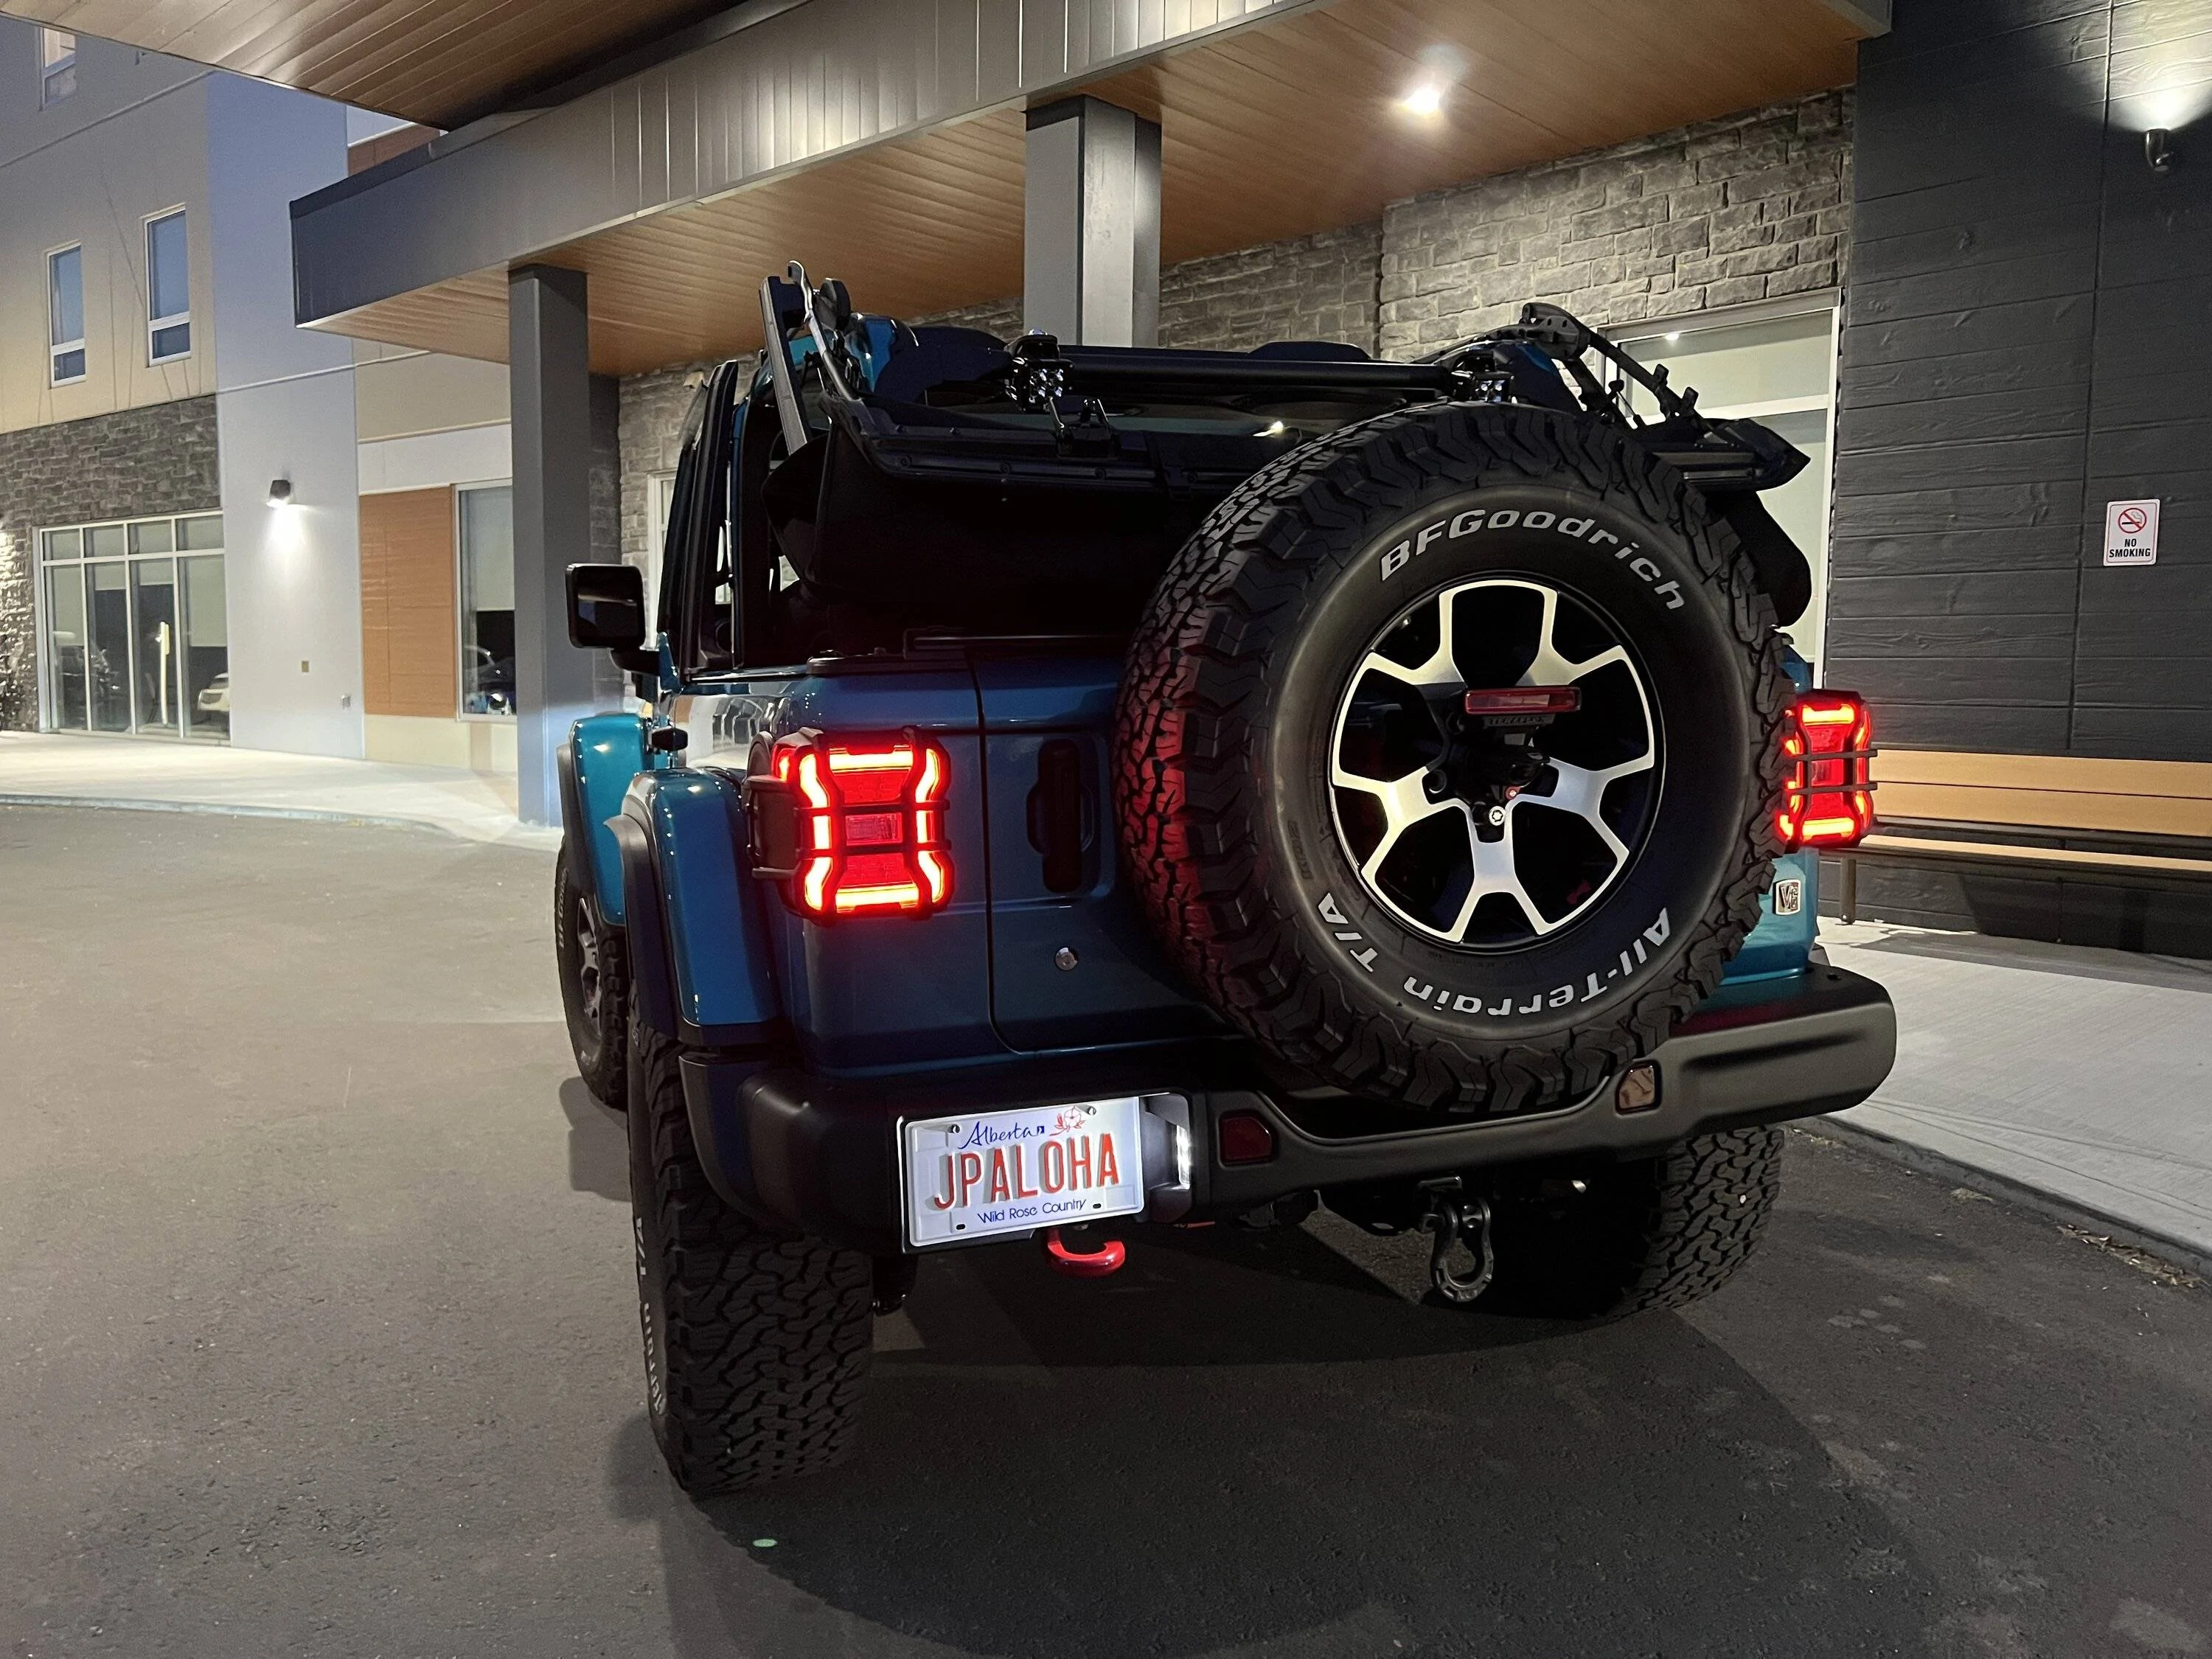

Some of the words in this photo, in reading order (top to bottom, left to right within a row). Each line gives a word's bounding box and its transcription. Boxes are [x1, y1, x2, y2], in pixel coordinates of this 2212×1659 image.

[1381, 509, 1685, 610] BFGoodrich
[2109, 548, 2151, 557] SMOKING
[2124, 538, 2137, 547] NO
[1318, 892, 1378, 973] T/A
[1403, 908, 1671, 1016] All-Terrain
[957, 1121, 1038, 1149] Alberta
[933, 1133, 1120, 1210] JPALOHA
[978, 1210, 1005, 1223] Wild
[1009, 1206, 1038, 1220] Rose
[1043, 1199, 1087, 1214] Country
